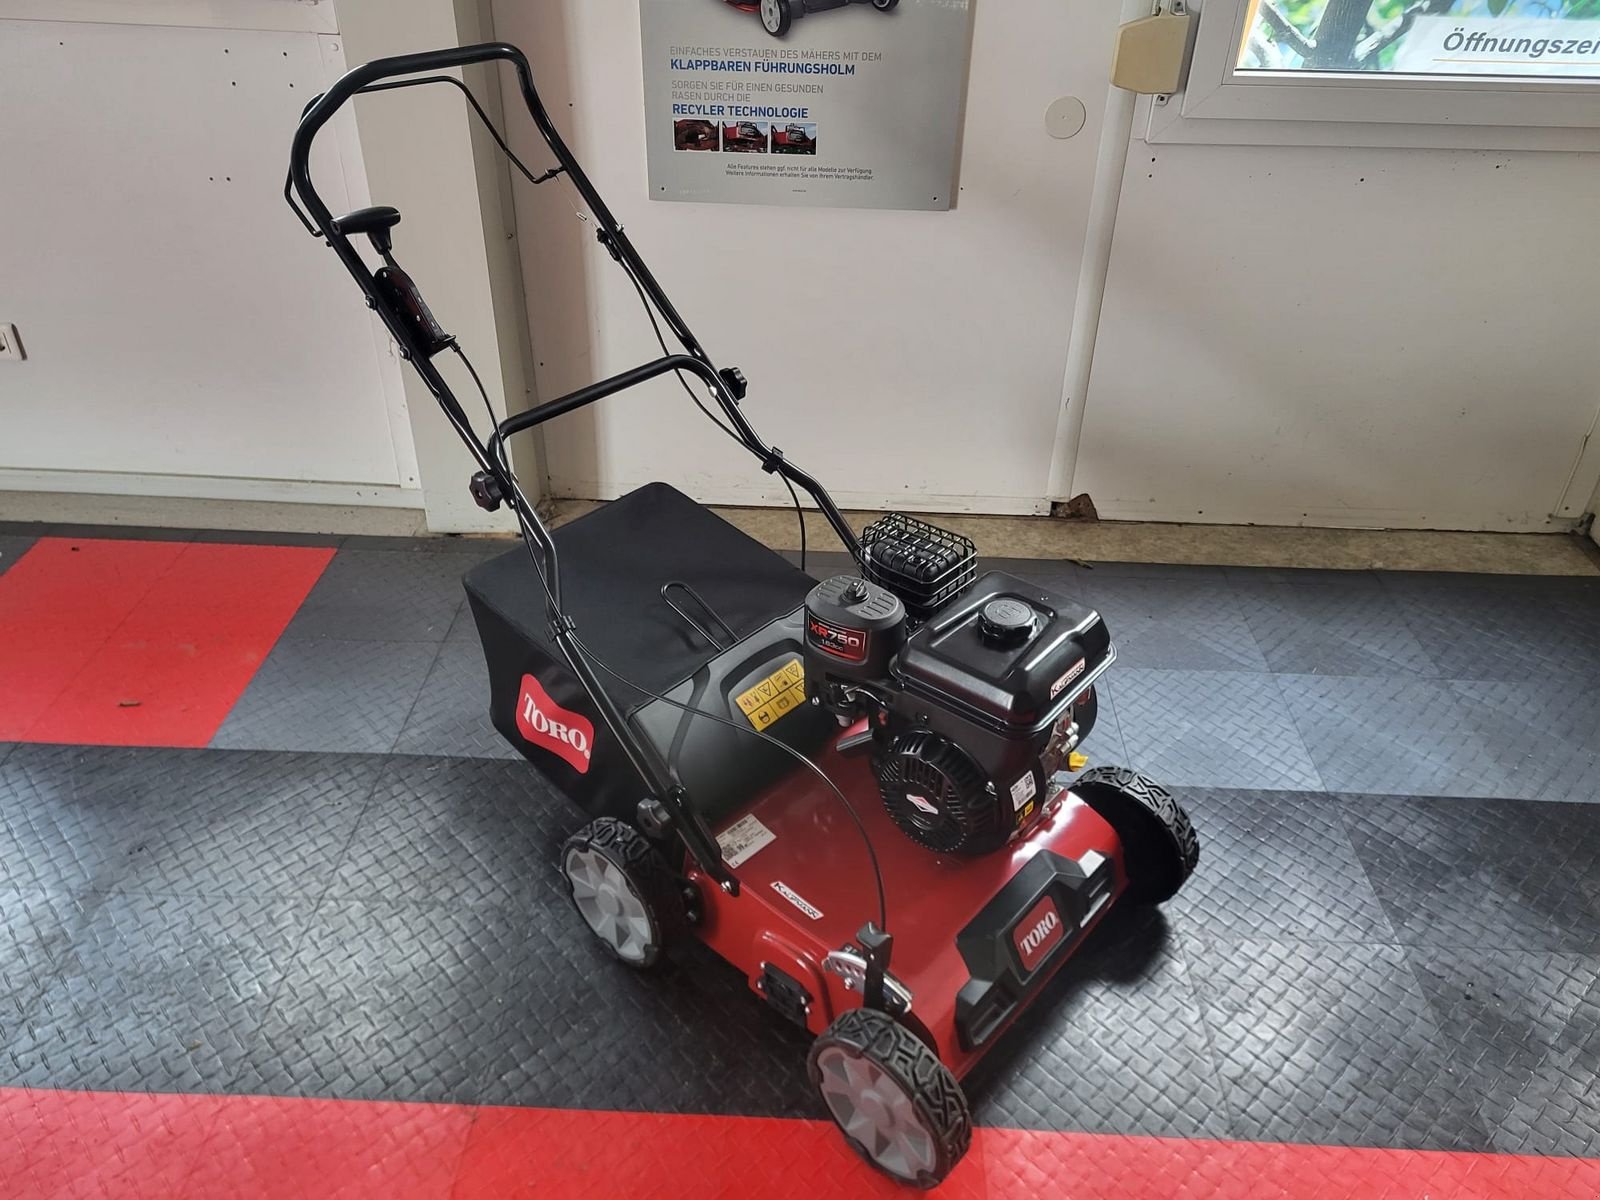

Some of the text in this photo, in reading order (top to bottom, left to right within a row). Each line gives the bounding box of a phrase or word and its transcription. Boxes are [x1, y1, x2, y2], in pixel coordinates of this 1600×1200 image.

[670, 46, 882, 61] EINFACHES VERSTAUEN DES MÄHERS MIT DEM
[670, 58, 855, 75] KLAPPBAREN FÜHRUNGSHOLM
[671, 79, 824, 94] SORGEN SIE FÜR EINEN GESUNDEN
[671, 90, 750, 102] RASEN DURCH DIE
[672, 103, 809, 119] RECYLER TECHNOLOGIE
[810, 621, 860, 647] XR750
[1020, 911, 1060, 956] TORO
